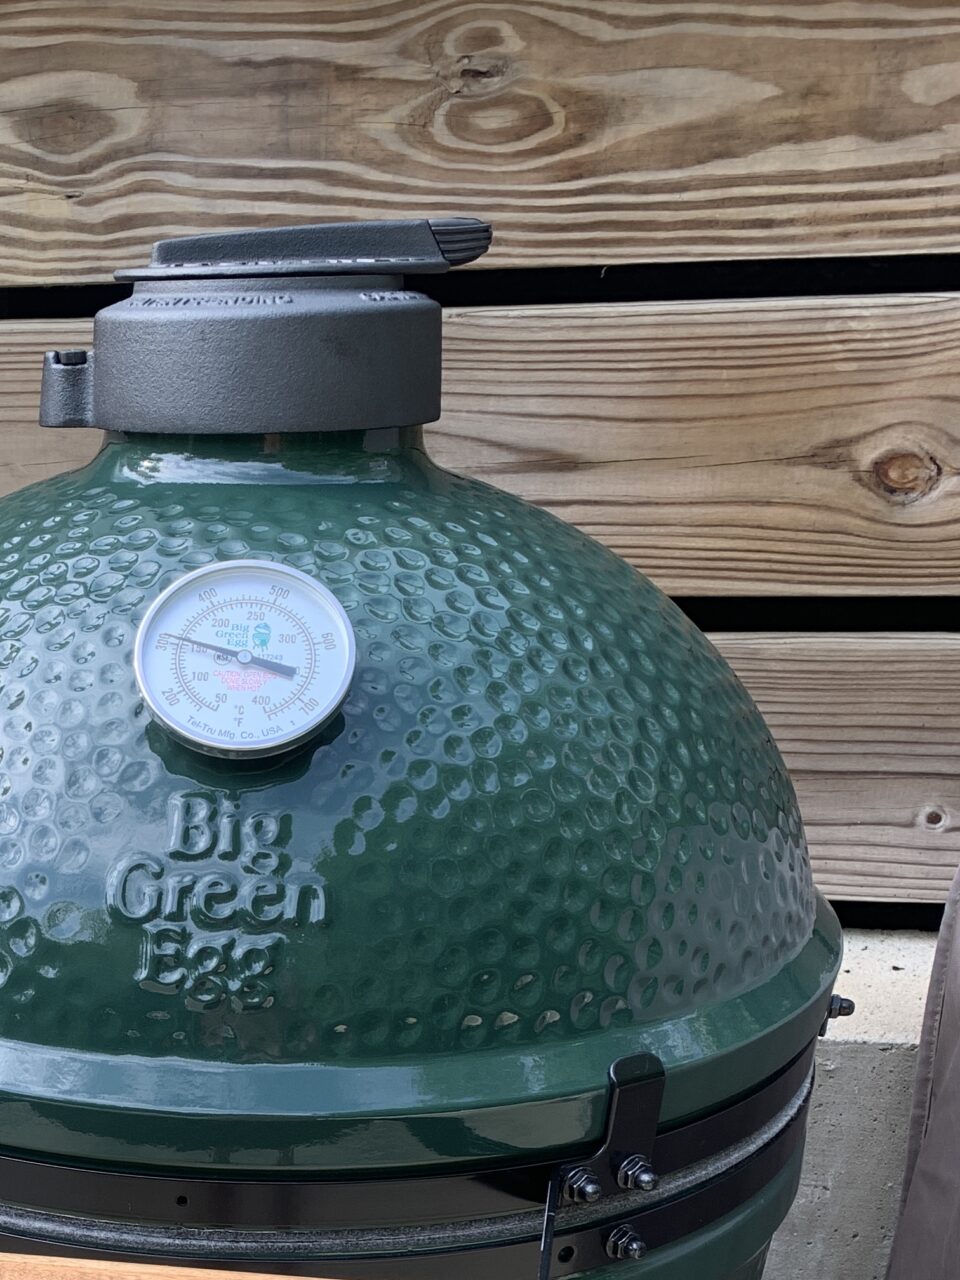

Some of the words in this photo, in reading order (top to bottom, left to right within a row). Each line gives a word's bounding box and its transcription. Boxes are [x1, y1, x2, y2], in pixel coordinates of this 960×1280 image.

[197, 587, 218, 602] 400
[268, 584, 290, 600] 500
[246, 610, 266, 621] 250
[211, 618, 230, 629] 200
[154, 632, 171, 652] 300
[278, 633, 297, 644] 300
[321, 632, 337, 650] 600
[191, 671, 209, 682] 100
[161, 687, 181, 706] 200
[215, 693, 228, 704] 50
[251, 695, 271, 706] 400
[298, 697, 320, 716] 700
[261, 724, 284, 737] USA
[167, 790, 293, 876] Big
[105, 851, 328, 928] Green
[132, 919, 288, 1009] Egg
